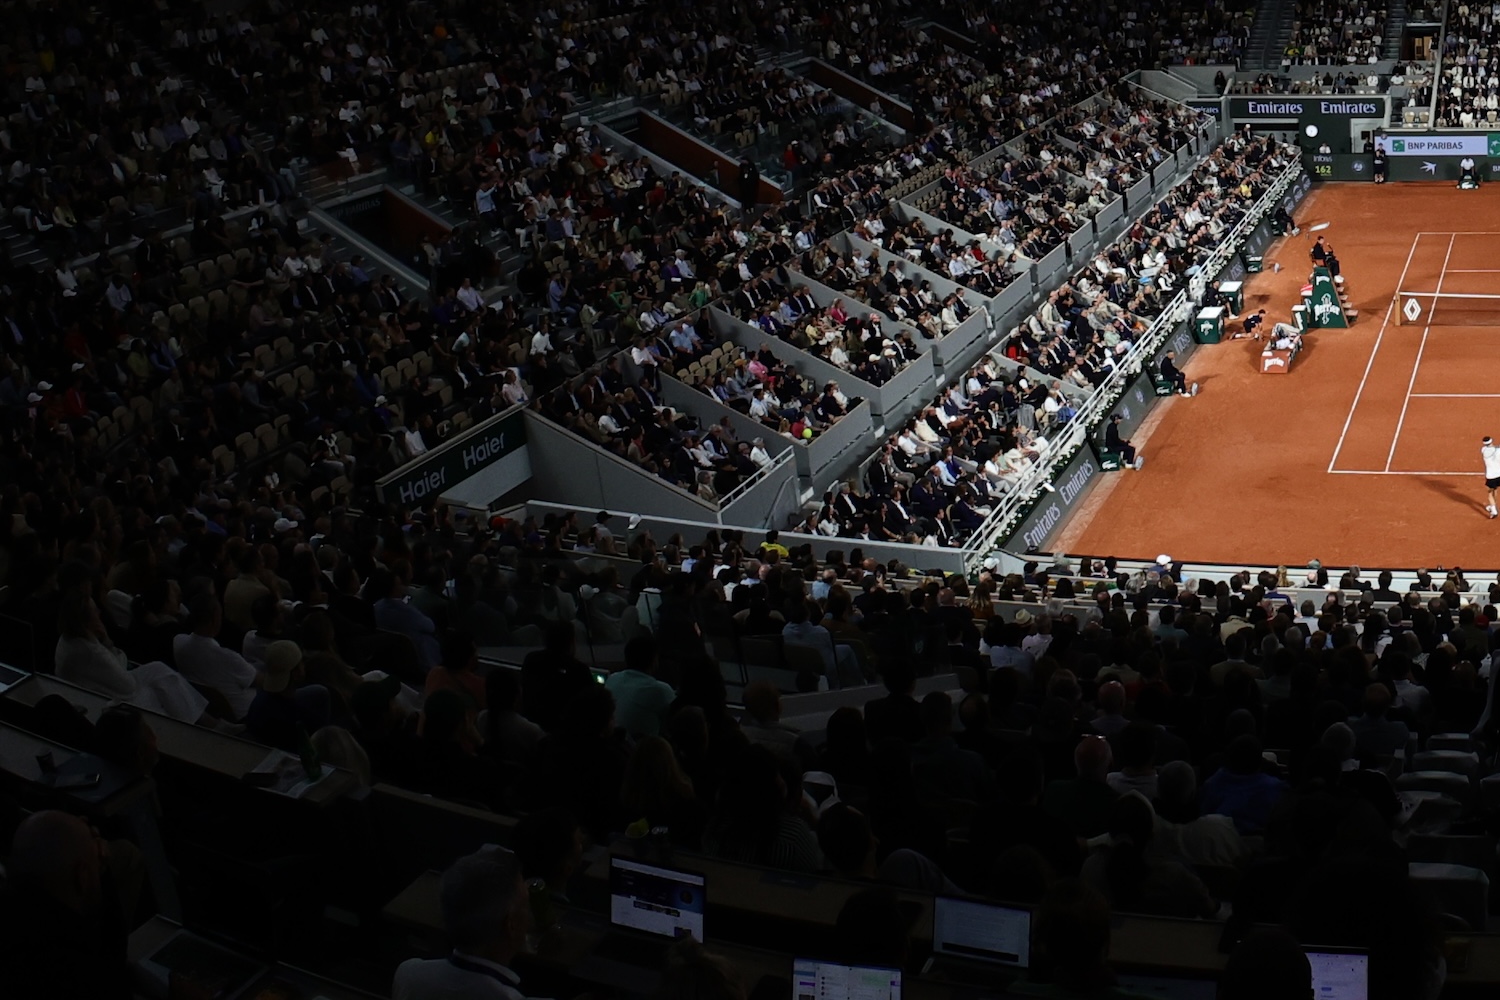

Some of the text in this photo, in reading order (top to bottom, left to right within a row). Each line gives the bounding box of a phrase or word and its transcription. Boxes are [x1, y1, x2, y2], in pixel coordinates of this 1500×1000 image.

[1248, 101, 1303, 114] Emirates
[1321, 101, 1376, 114] Emirates
[1407, 141, 1463, 150] BNP PARIBAS
[1315, 165, 1331, 174] 162
[462, 432, 505, 471] Haier
[399, 466, 446, 504] Haier
[1059, 459, 1094, 506] Emirates
[1023, 502, 1061, 547] Emirates
